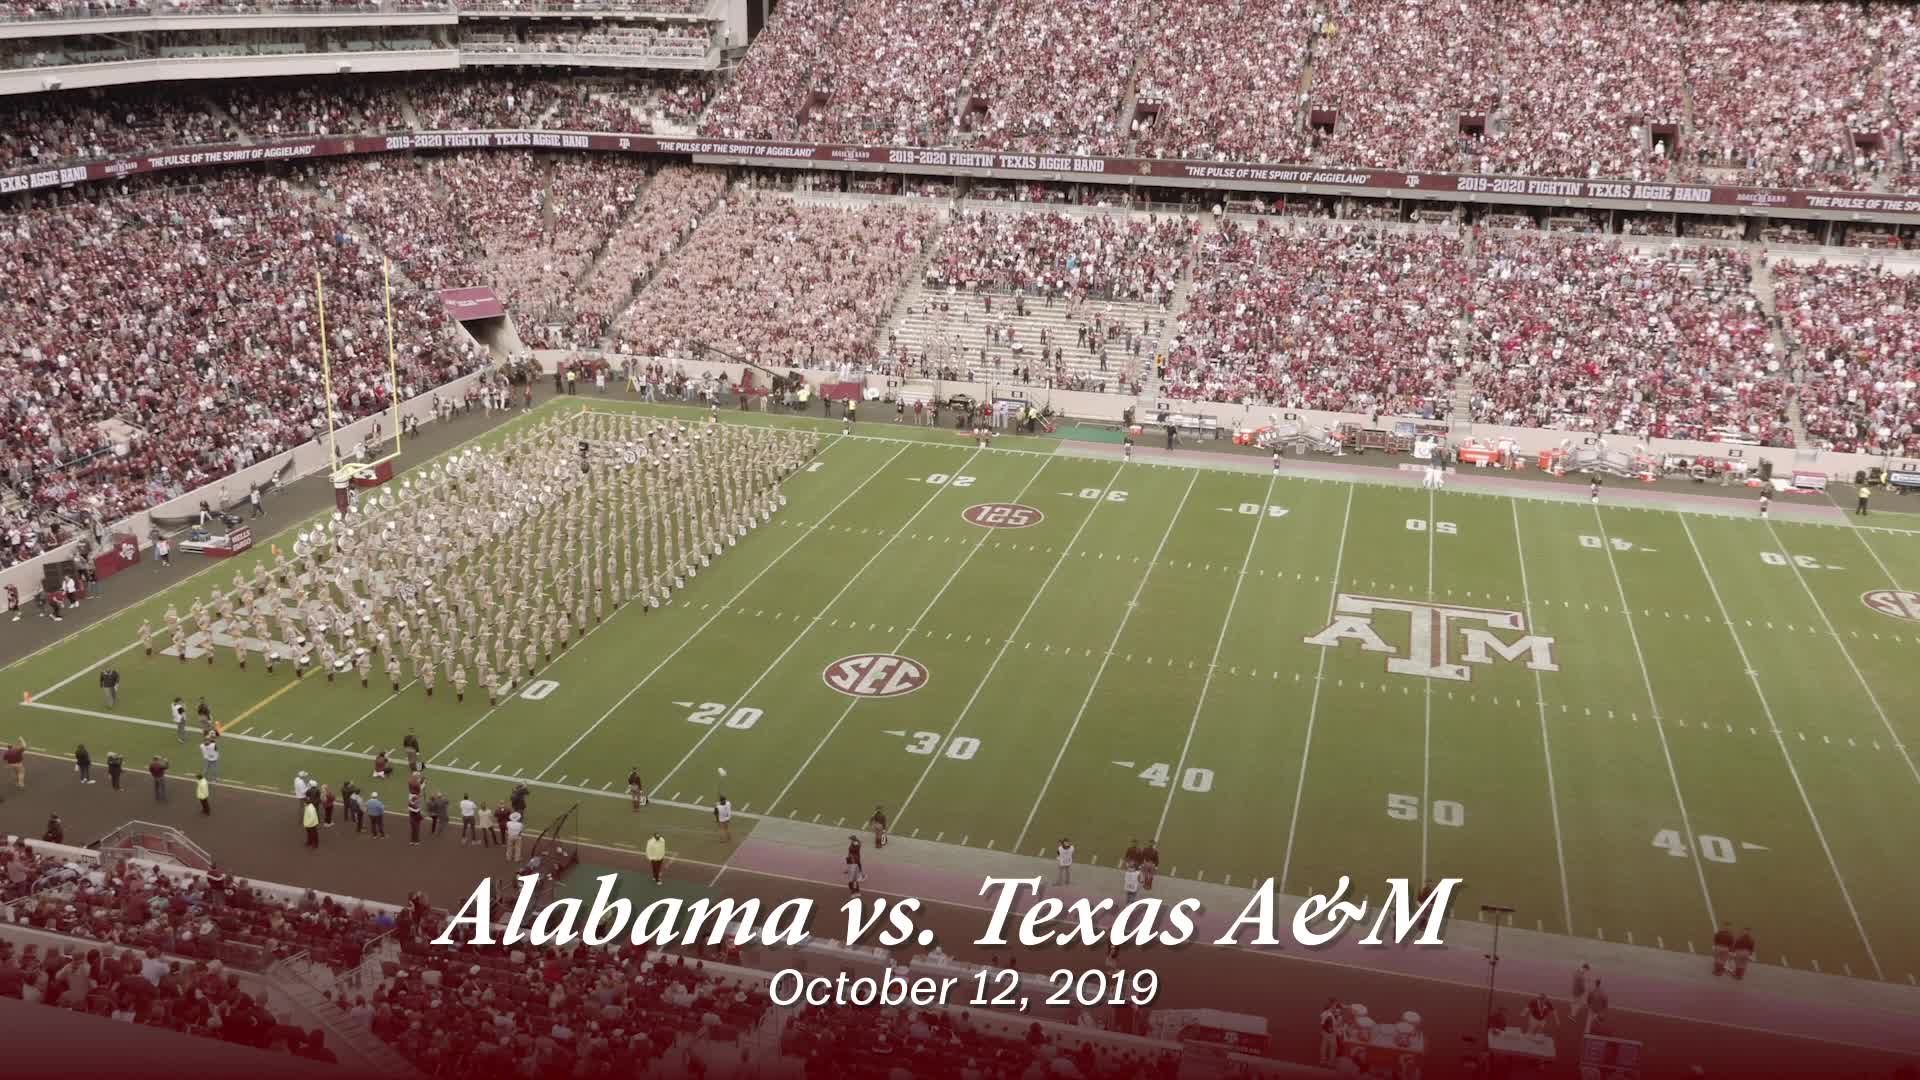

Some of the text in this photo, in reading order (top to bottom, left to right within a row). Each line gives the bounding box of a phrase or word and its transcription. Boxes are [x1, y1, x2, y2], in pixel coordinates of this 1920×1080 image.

[385, 134, 442, 150] 2019-2020
[494, 133, 532, 146] TEXAS
[533, 134, 561, 147] AGGIE
[562, 135, 589, 148] BAND
[675, 142, 701, 152] PULSE
[701, 144, 712, 153] OF
[713, 144, 728, 154] THE
[728, 145, 754, 155] SPIRIT
[754, 146, 766, 156] OF
[164, 154, 190, 166] PULSE
[191, 154, 204, 164] OF
[205, 152, 222, 163] THE
[222, 150, 251, 162] SPIRIT
[251, 149, 263, 160] OF
[888, 150, 947, 165] 2019-2020
[999, 155, 1036, 170] TEXAS
[1038, 157, 1072, 171] AGGIE
[1073, 159, 1105, 173] BAND
[30, 170, 60, 189] AGGIE
[60, 166, 88, 183] BAND
[1206, 167, 1236, 178] PULSE
[1236, 168, 1249, 179] OF
[1250, 169, 1269, 180] THE
[1269, 170, 1300, 181] SPIRIT
[1300, 172, 1312, 182] OF
[1457, 177, 1525, 193] 2019-2020
[1587, 183, 1630, 199] TEXAS
[1632, 185, 1673, 200] AGGIE
[1674, 187, 1712, 203] BAND
[1831, 197, 1864, 209] PULSE
[1865, 198, 1882, 210] OF
[1882, 200, 1904, 210] THE
[831, 656, 920, 695] SEC
[687, 701, 764, 731] 20
[904, 730, 982, 760] 30
[1138, 762, 1214, 793] 40
[1387, 793, 1465, 827] 50
[1651, 828, 1737, 864] 40
